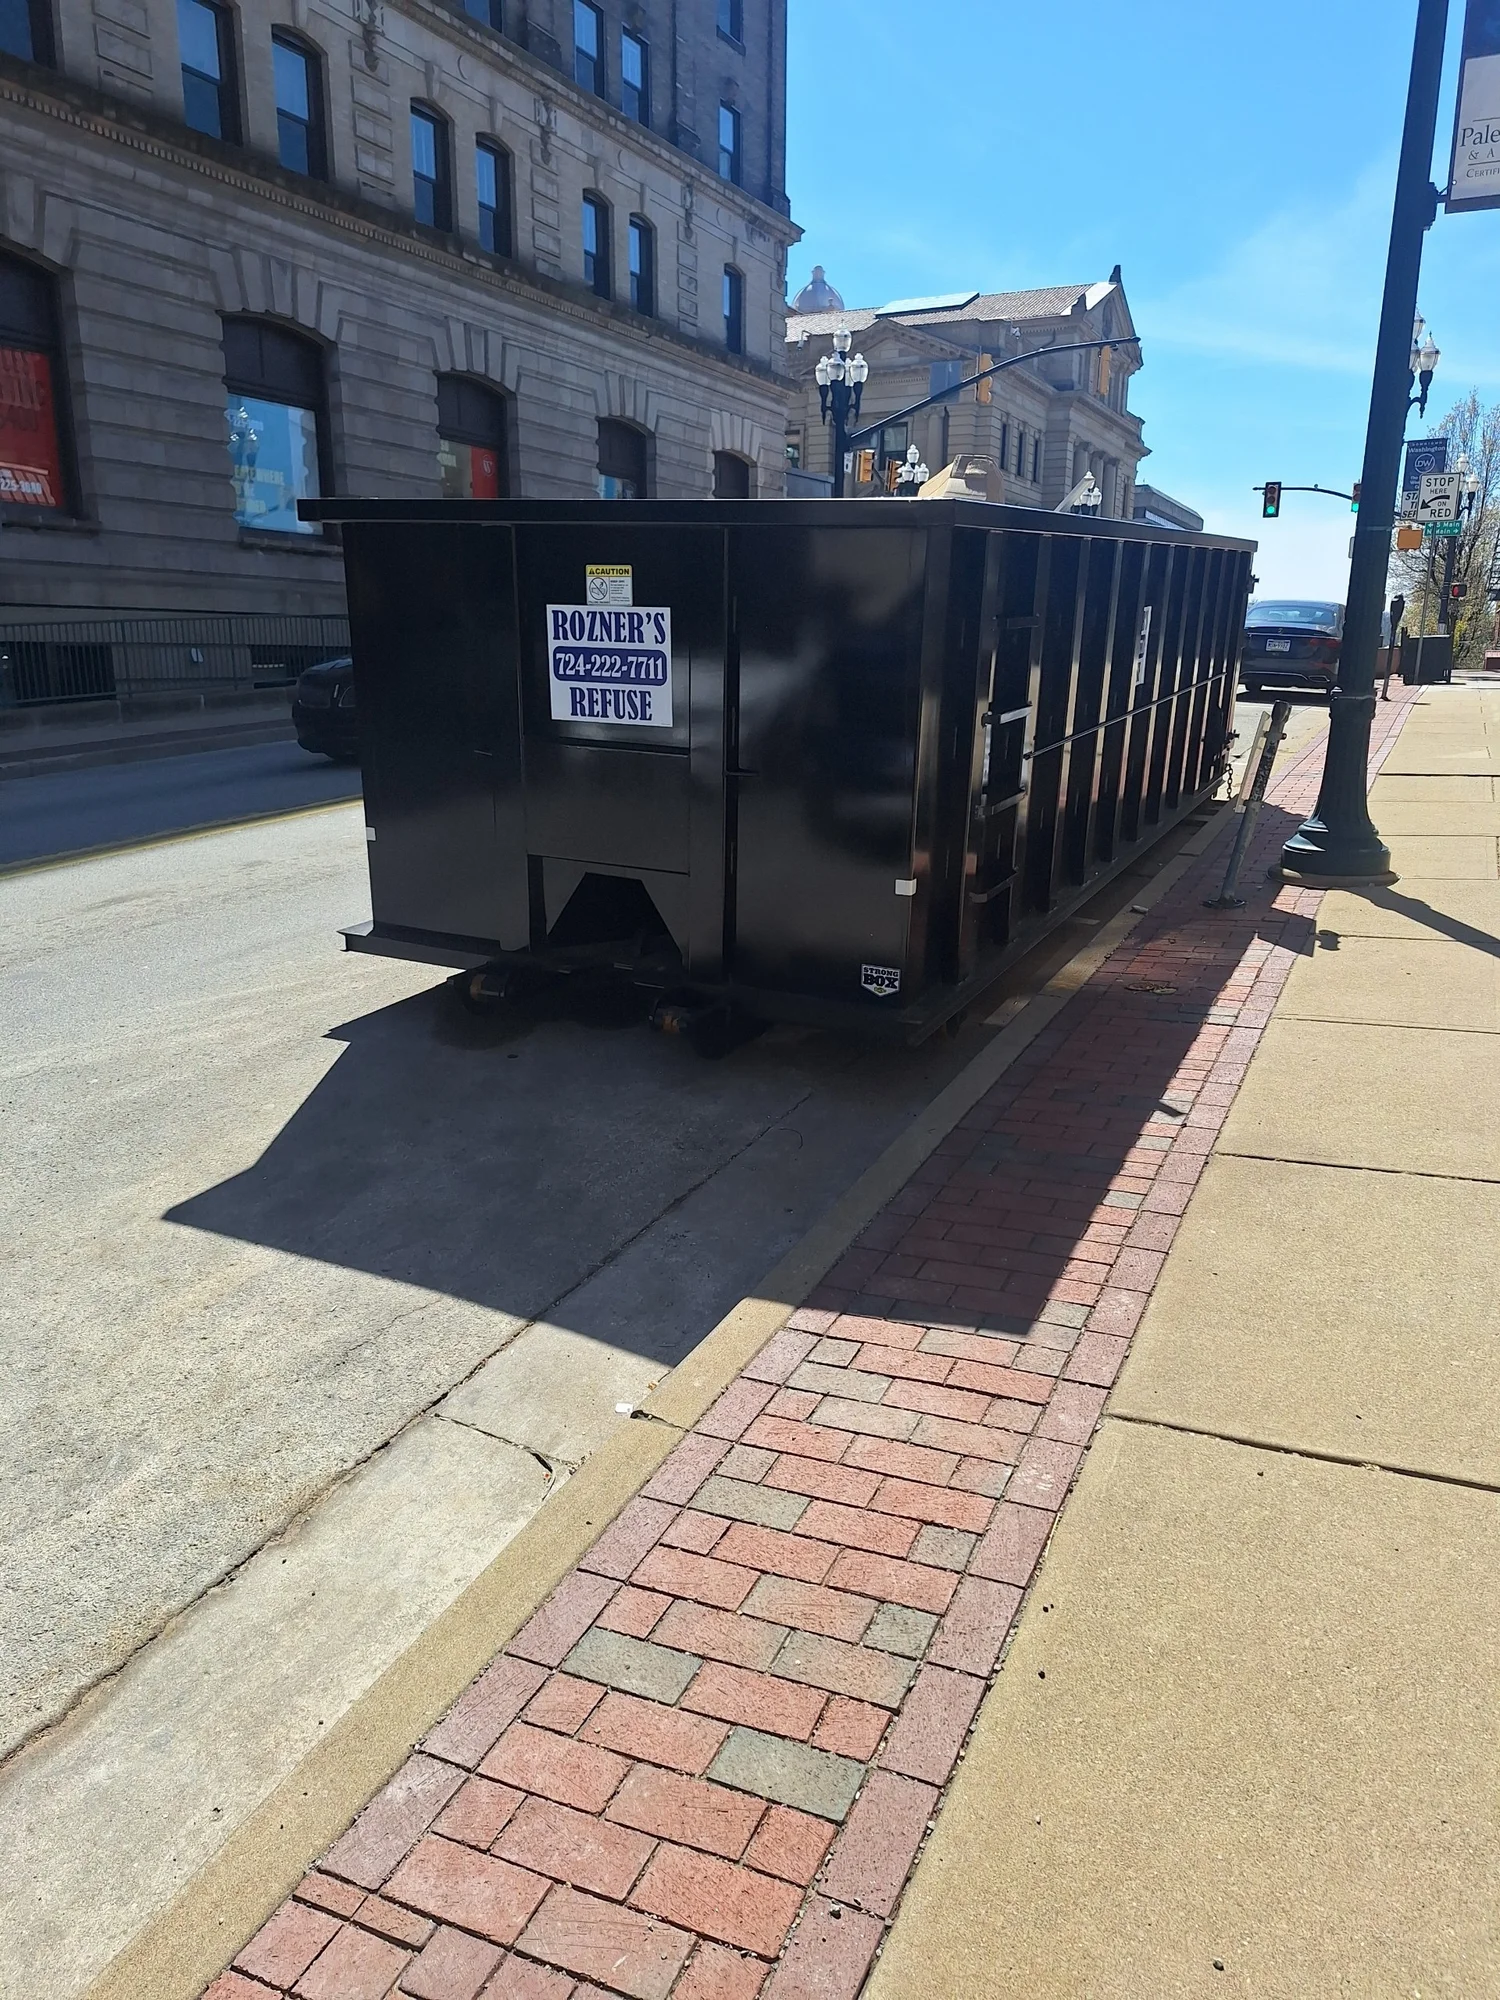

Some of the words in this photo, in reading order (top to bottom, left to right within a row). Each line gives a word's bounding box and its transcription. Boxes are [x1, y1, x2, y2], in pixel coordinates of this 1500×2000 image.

[1468, 149, 1480, 161] &
[1407, 446, 1446, 454] Washington
[1425, 476, 1455, 487] STOP
[1430, 508, 1452, 518] RED
[552, 610, 666, 645] ROZNER'S
[556, 653, 664, 680] 724-222-7711
[570, 686, 653, 721] REFUSE
[863, 967, 899, 978] STRONG
[863, 973, 899, 989] BOX
